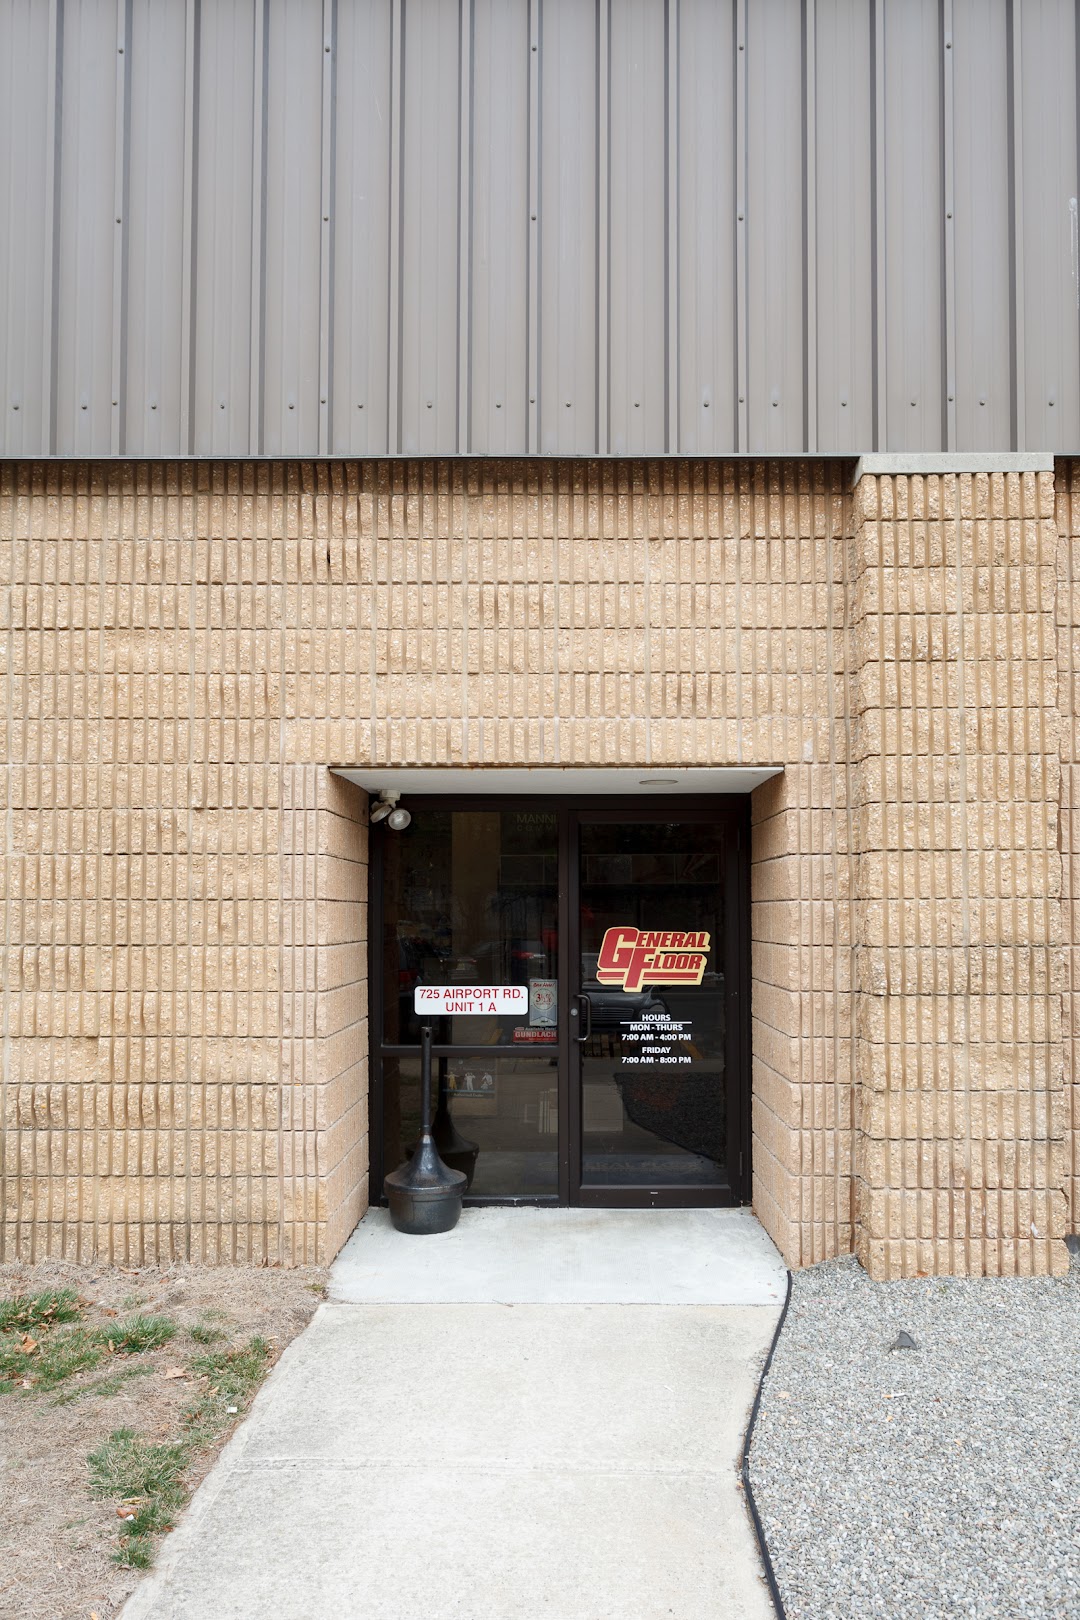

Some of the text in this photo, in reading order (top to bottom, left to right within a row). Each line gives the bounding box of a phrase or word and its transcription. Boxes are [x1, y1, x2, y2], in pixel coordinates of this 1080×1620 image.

[598, 928, 707, 969] GENERAL
[624, 947, 703, 988] FLOOR
[419, 988, 524, 999] 725 AIRPORT RD.
[445, 1002, 497, 1012] UNIT 1 A
[641, 1013, 671, 1022] HOURS
[621, 1033, 639, 1041] 7:00
[640, 1033, 654, 1041] AM
[659, 1033, 677, 1041] 4:00
[678, 1033, 692, 1041] PM
[641, 1046, 671, 1054] FRIDAY
[621, 1056, 639, 1064] 7:00
[640, 1056, 654, 1064] AM
[659, 1056, 677, 1064] 8:00
[678, 1056, 692, 1064] PM
